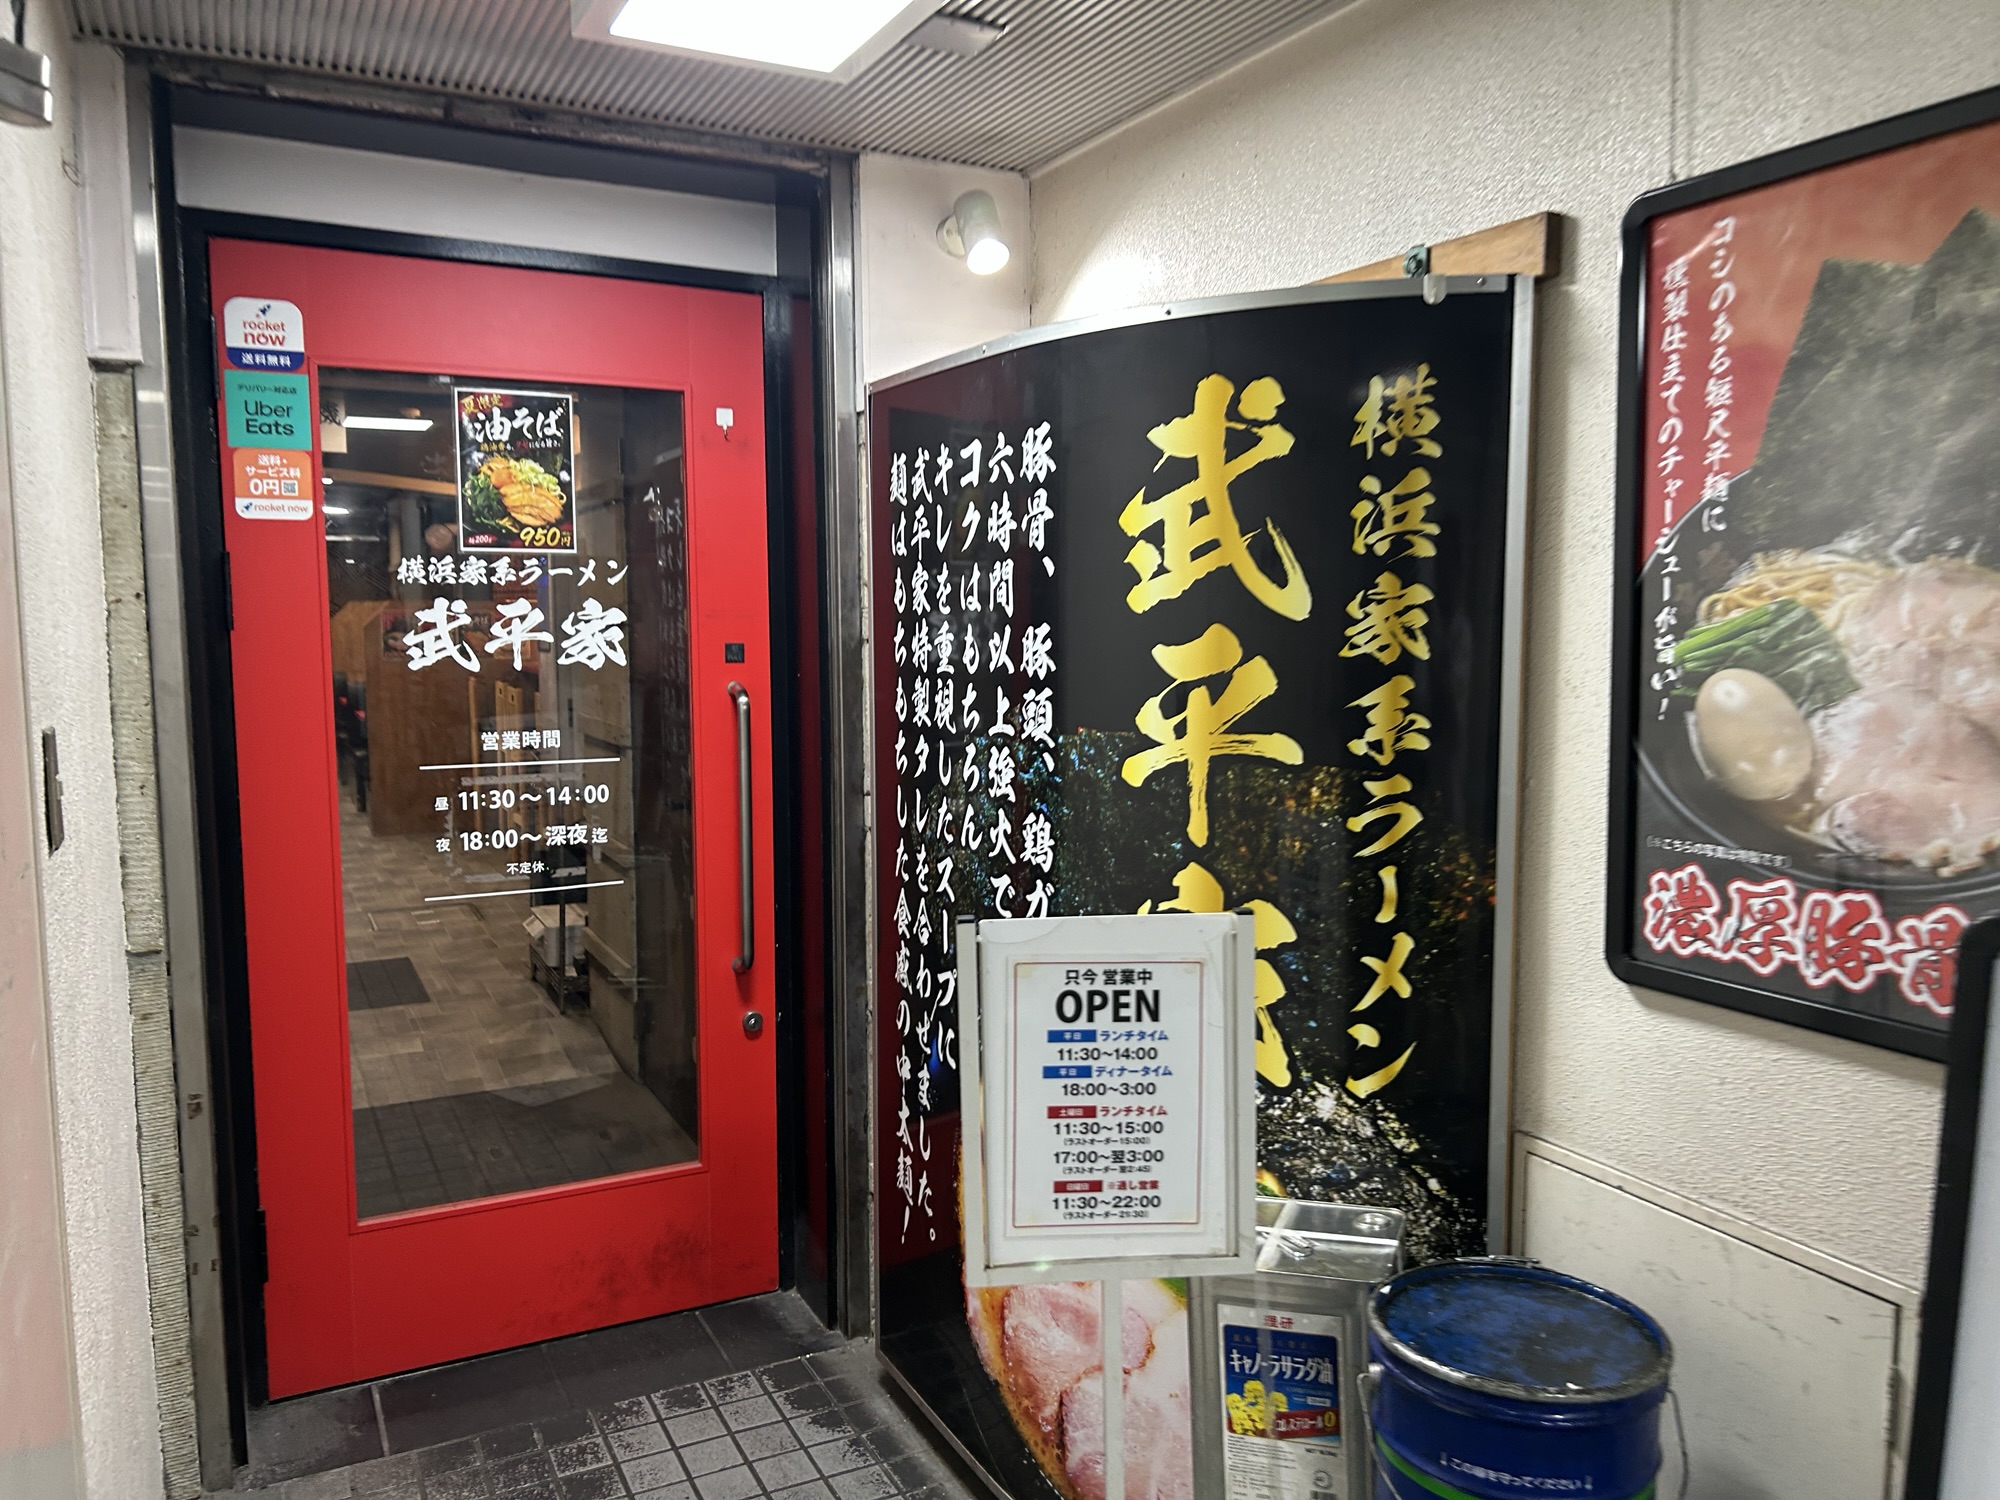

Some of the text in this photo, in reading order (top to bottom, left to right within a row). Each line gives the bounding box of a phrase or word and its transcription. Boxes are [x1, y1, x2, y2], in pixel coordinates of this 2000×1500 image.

[243, 320, 285, 332] rocket
[243, 332, 286, 346] now
[241, 352, 291, 367] 送料無料
[244, 399, 293, 418] Uber
[245, 418, 295, 436] Eats
[473, 405, 564, 443] 油そば
[245, 465, 301, 480] サービス料
[249, 478, 280, 496] 0円
[254, 503, 309, 513] rocket now
[397, 554, 628, 587] 横浜家系ラーメン
[403, 597, 628, 673] 武平家
[960, 438, 983, 851] コクはもちろん
[1338, 362, 1444, 1099] 横浜家系ラーメン
[480, 729, 561, 751] 営業時間
[434, 797, 449, 811] 昼
[435, 838, 451, 852] 夜
[506, 861, 545, 875] 不定休
[1055, 989, 1161, 1023] OPEN
[1099, 1030, 1169, 1041] ランチタイム
[1056, 1047, 1158, 1061] 11:30〜14:00
[1095, 1065, 1173, 1077] ディナータイム
[1061, 1082, 1156, 1096] 18:00〜3:00
[1099, 1105, 1168, 1116] ランチタイム
[1053, 1121, 1164, 1134] 11:30〜15:00
[1052, 1195, 1161, 1209] 11:30〜22:00
[1229, 1348, 1334, 1385] キャノーラサラダ油
